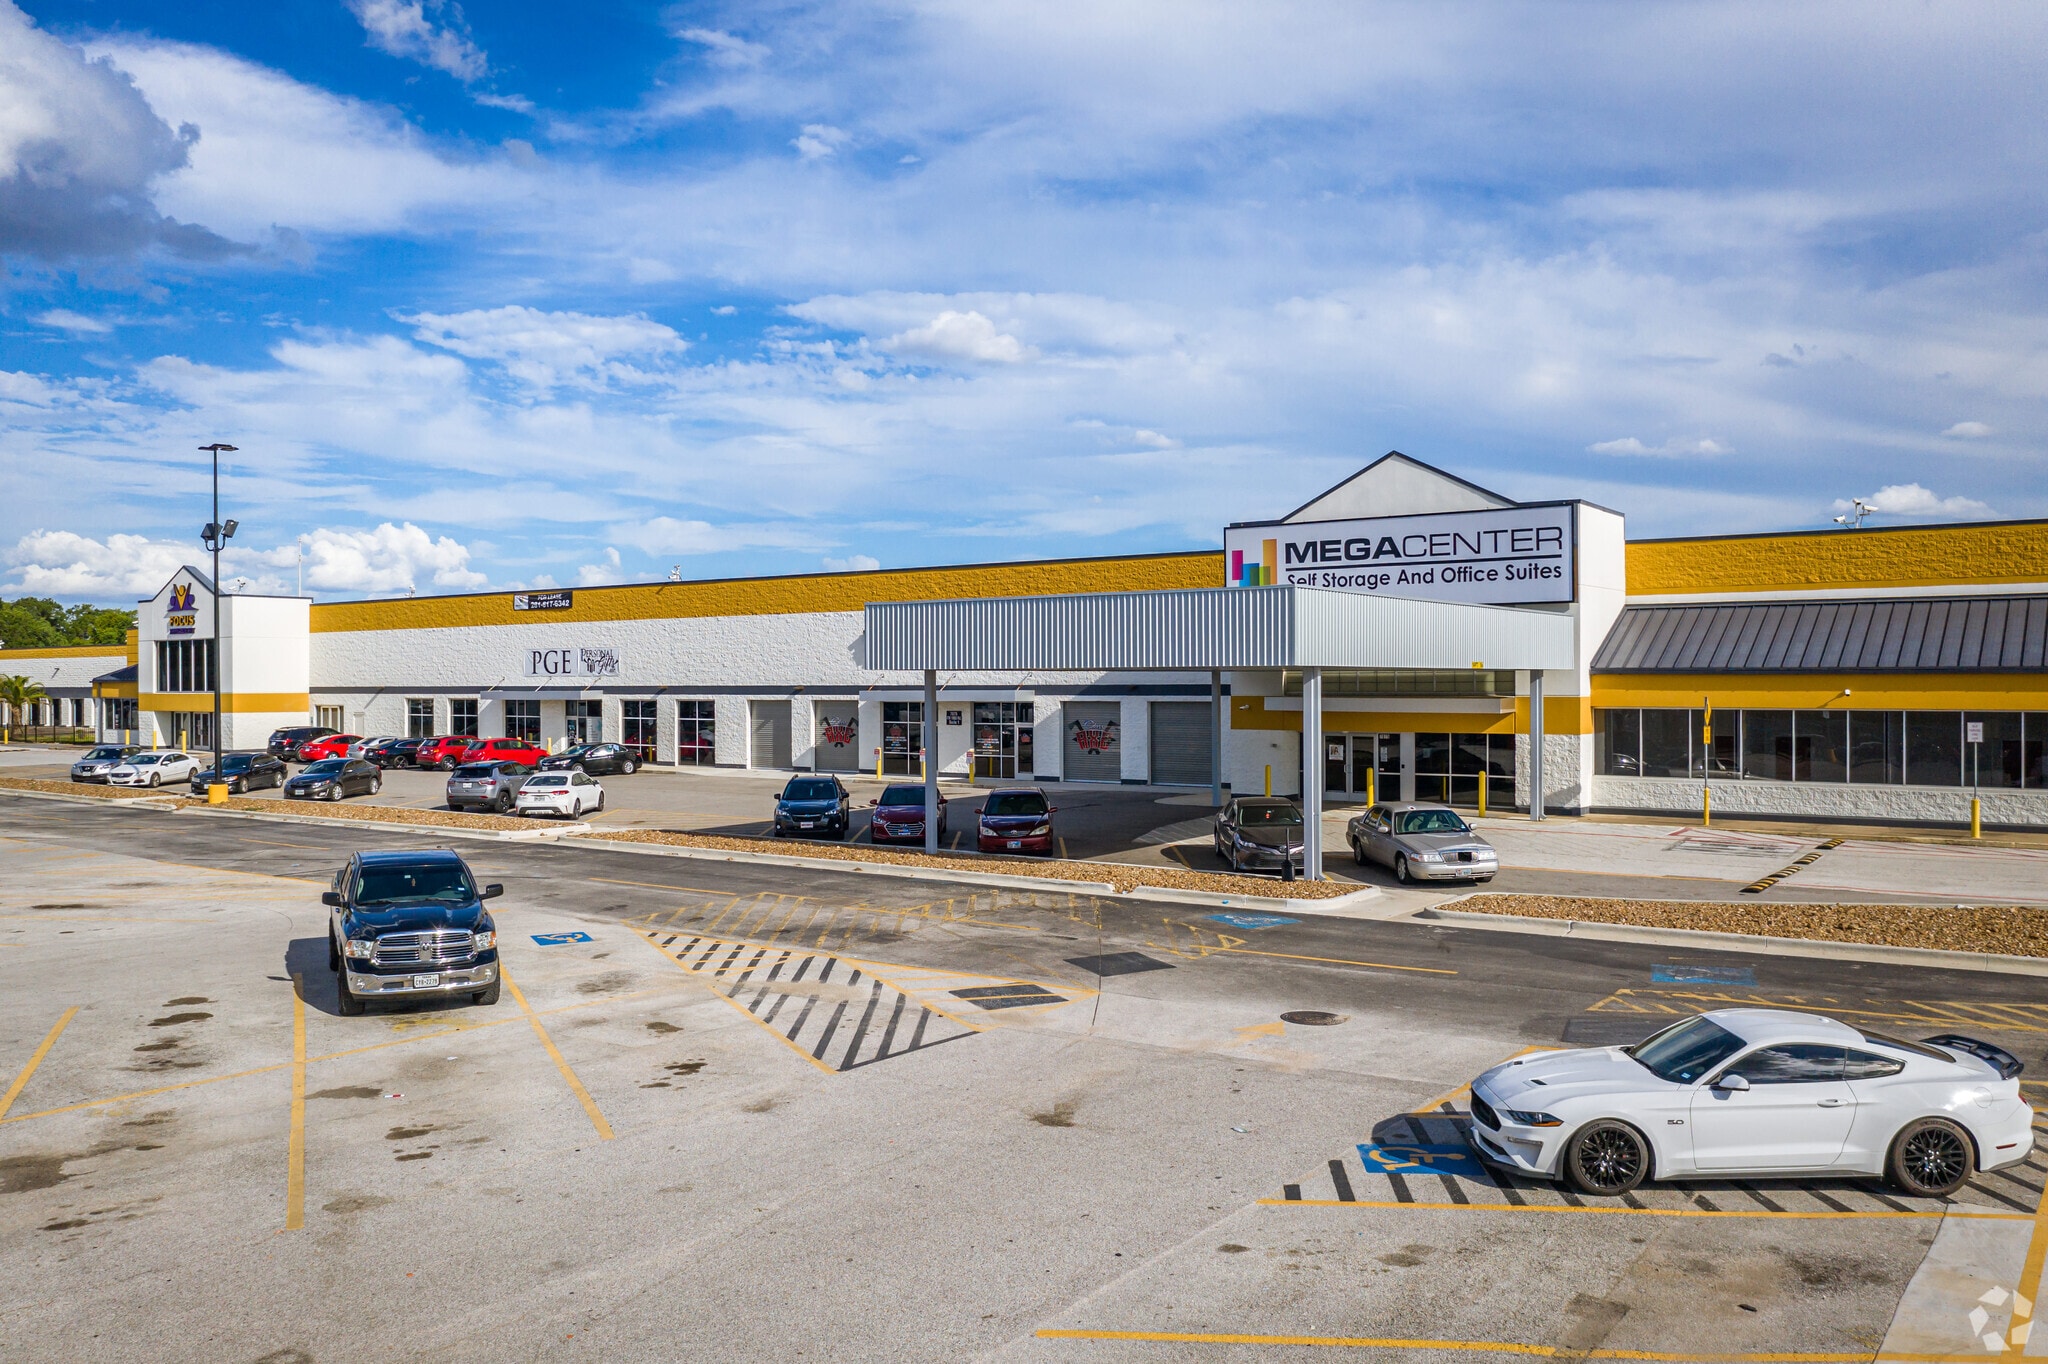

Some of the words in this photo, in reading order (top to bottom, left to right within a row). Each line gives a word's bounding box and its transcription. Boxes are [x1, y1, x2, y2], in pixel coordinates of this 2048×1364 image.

[1285, 526, 1563, 564] MEGACENTER
[1287, 573, 1317, 585] Self
[1322, 572, 1391, 590] Storage
[1397, 567, 1434, 585] And
[1441, 565, 1499, 584] Office
[1505, 563, 1562, 580] Suites
[169, 615, 195, 626] FOCUS
[531, 650, 572, 675] PGE
[580, 649, 613, 661] PERSONAL
[825, 725, 854, 744] AXE
[1076, 730, 1114, 750] AXE
